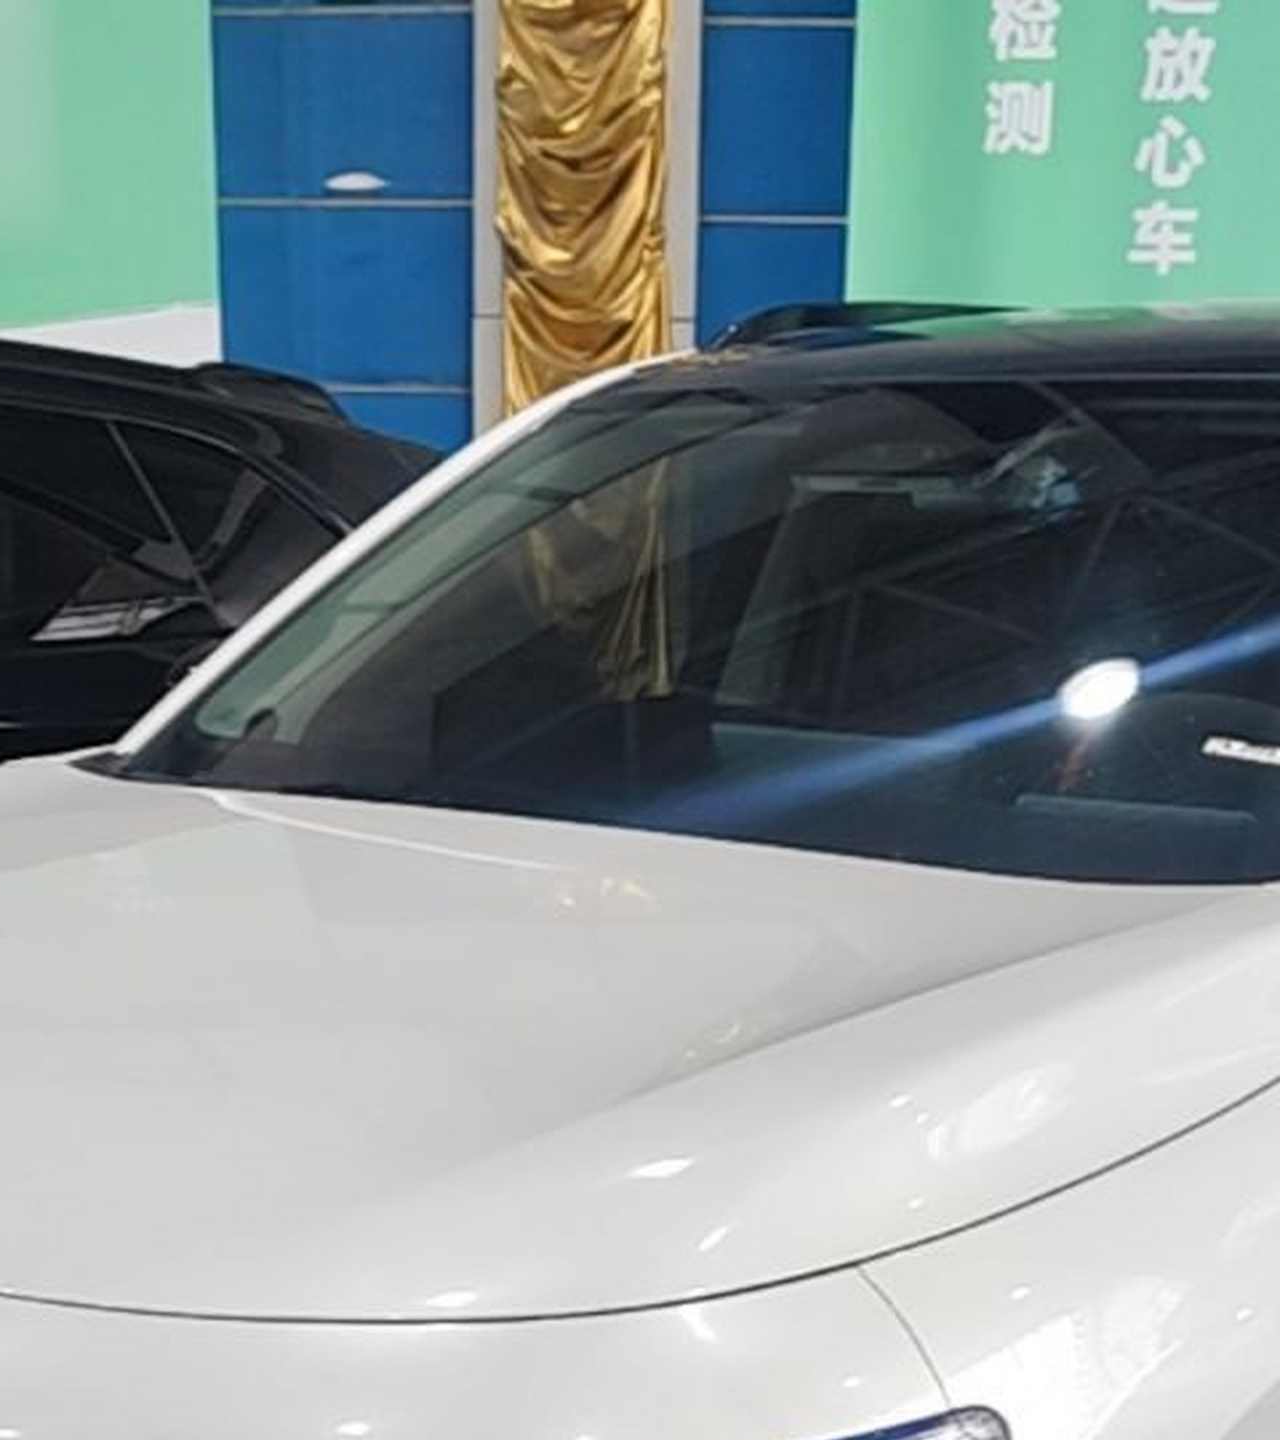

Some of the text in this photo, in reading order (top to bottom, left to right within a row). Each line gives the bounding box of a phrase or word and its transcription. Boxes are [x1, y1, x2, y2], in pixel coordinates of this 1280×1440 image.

[984, 0, 1061, 154] 检测
[1128, 0, 1219, 274] 放心车
